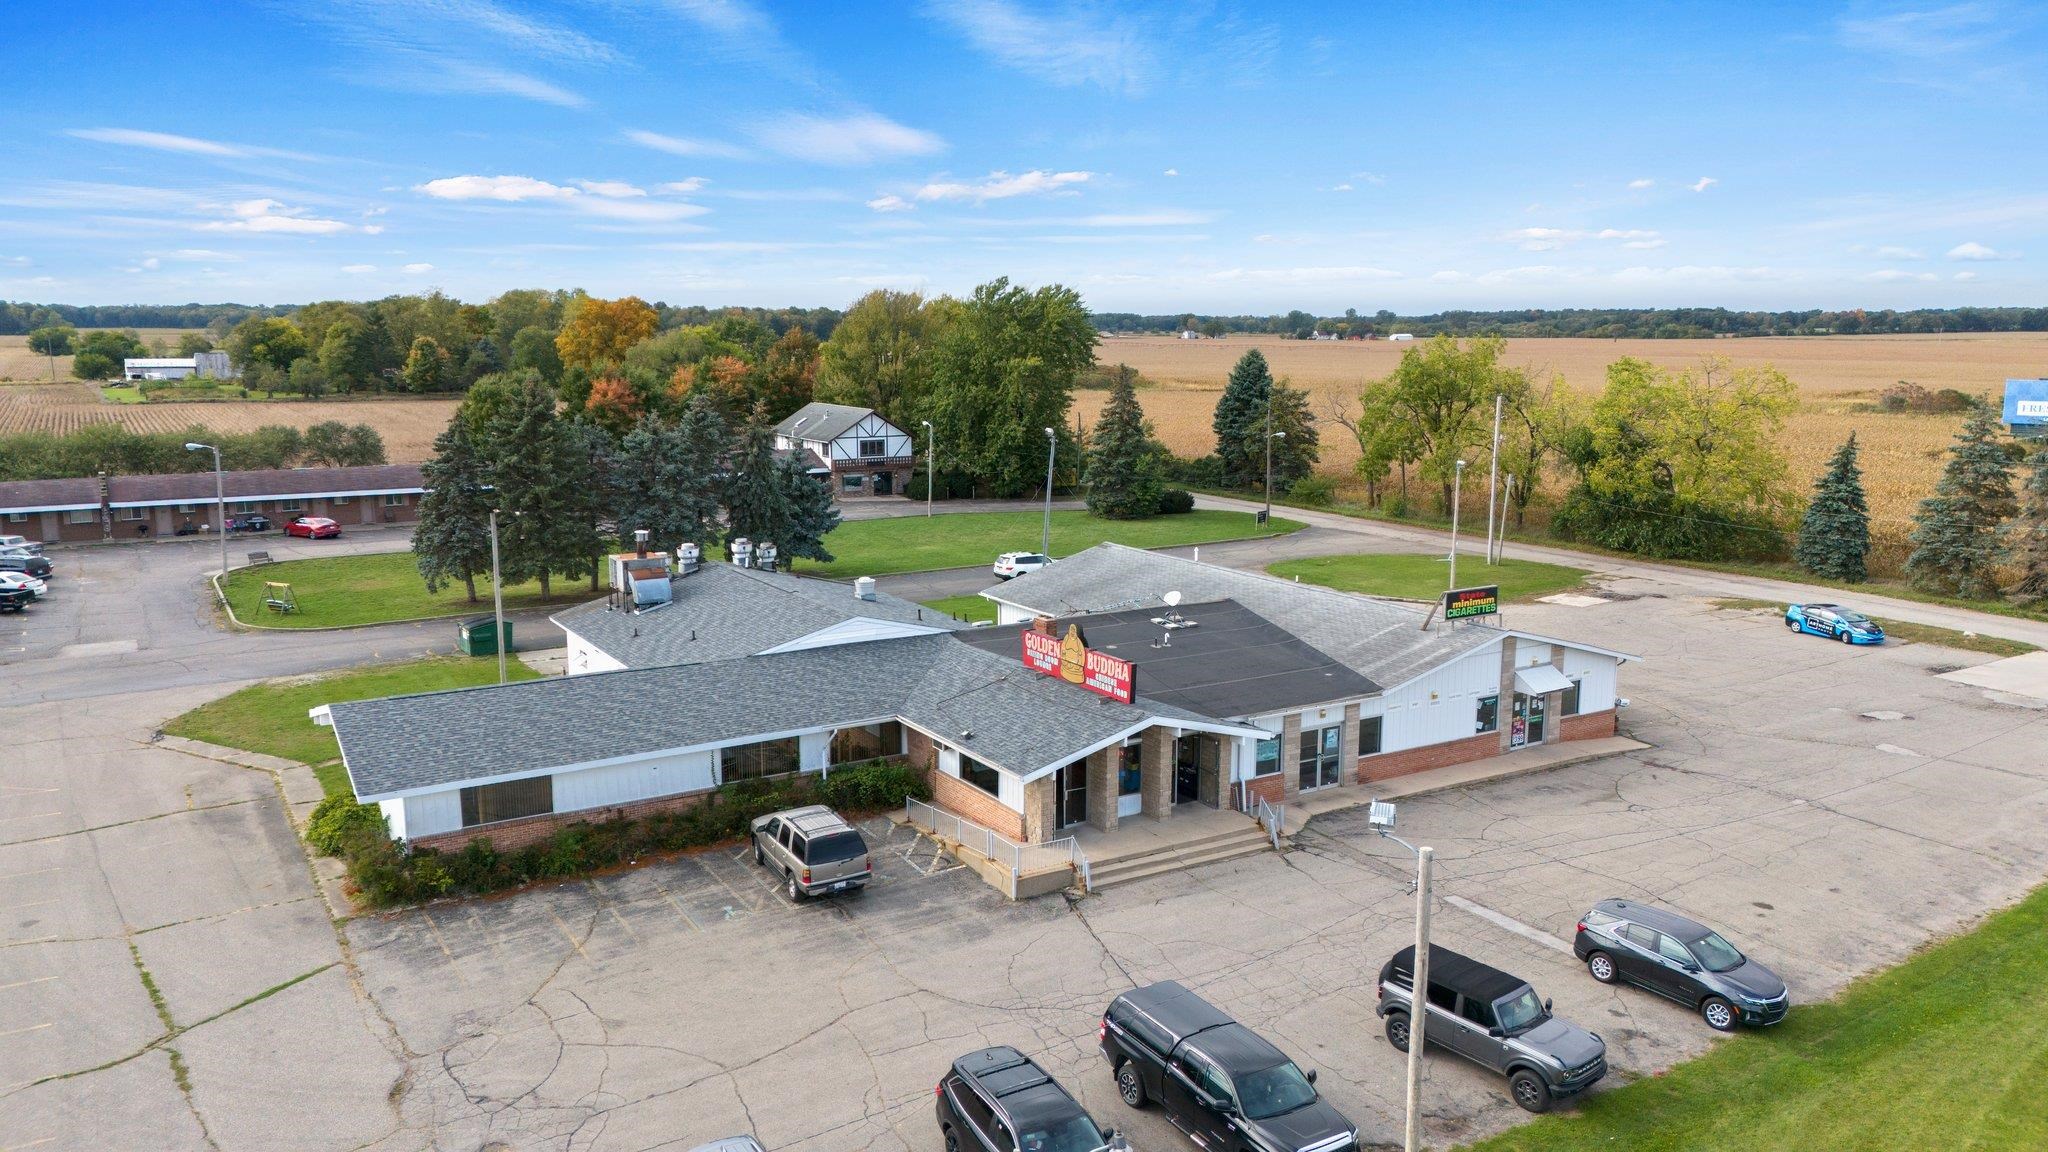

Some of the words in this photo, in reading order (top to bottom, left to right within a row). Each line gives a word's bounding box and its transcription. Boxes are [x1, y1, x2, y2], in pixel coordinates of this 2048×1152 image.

[1452, 597, 1495, 608] minimum
[1447, 603, 1496, 618] CIGARETTES
[1025, 632, 1061, 659] GOLDEN
[1087, 652, 1130, 682] BUDDHA
